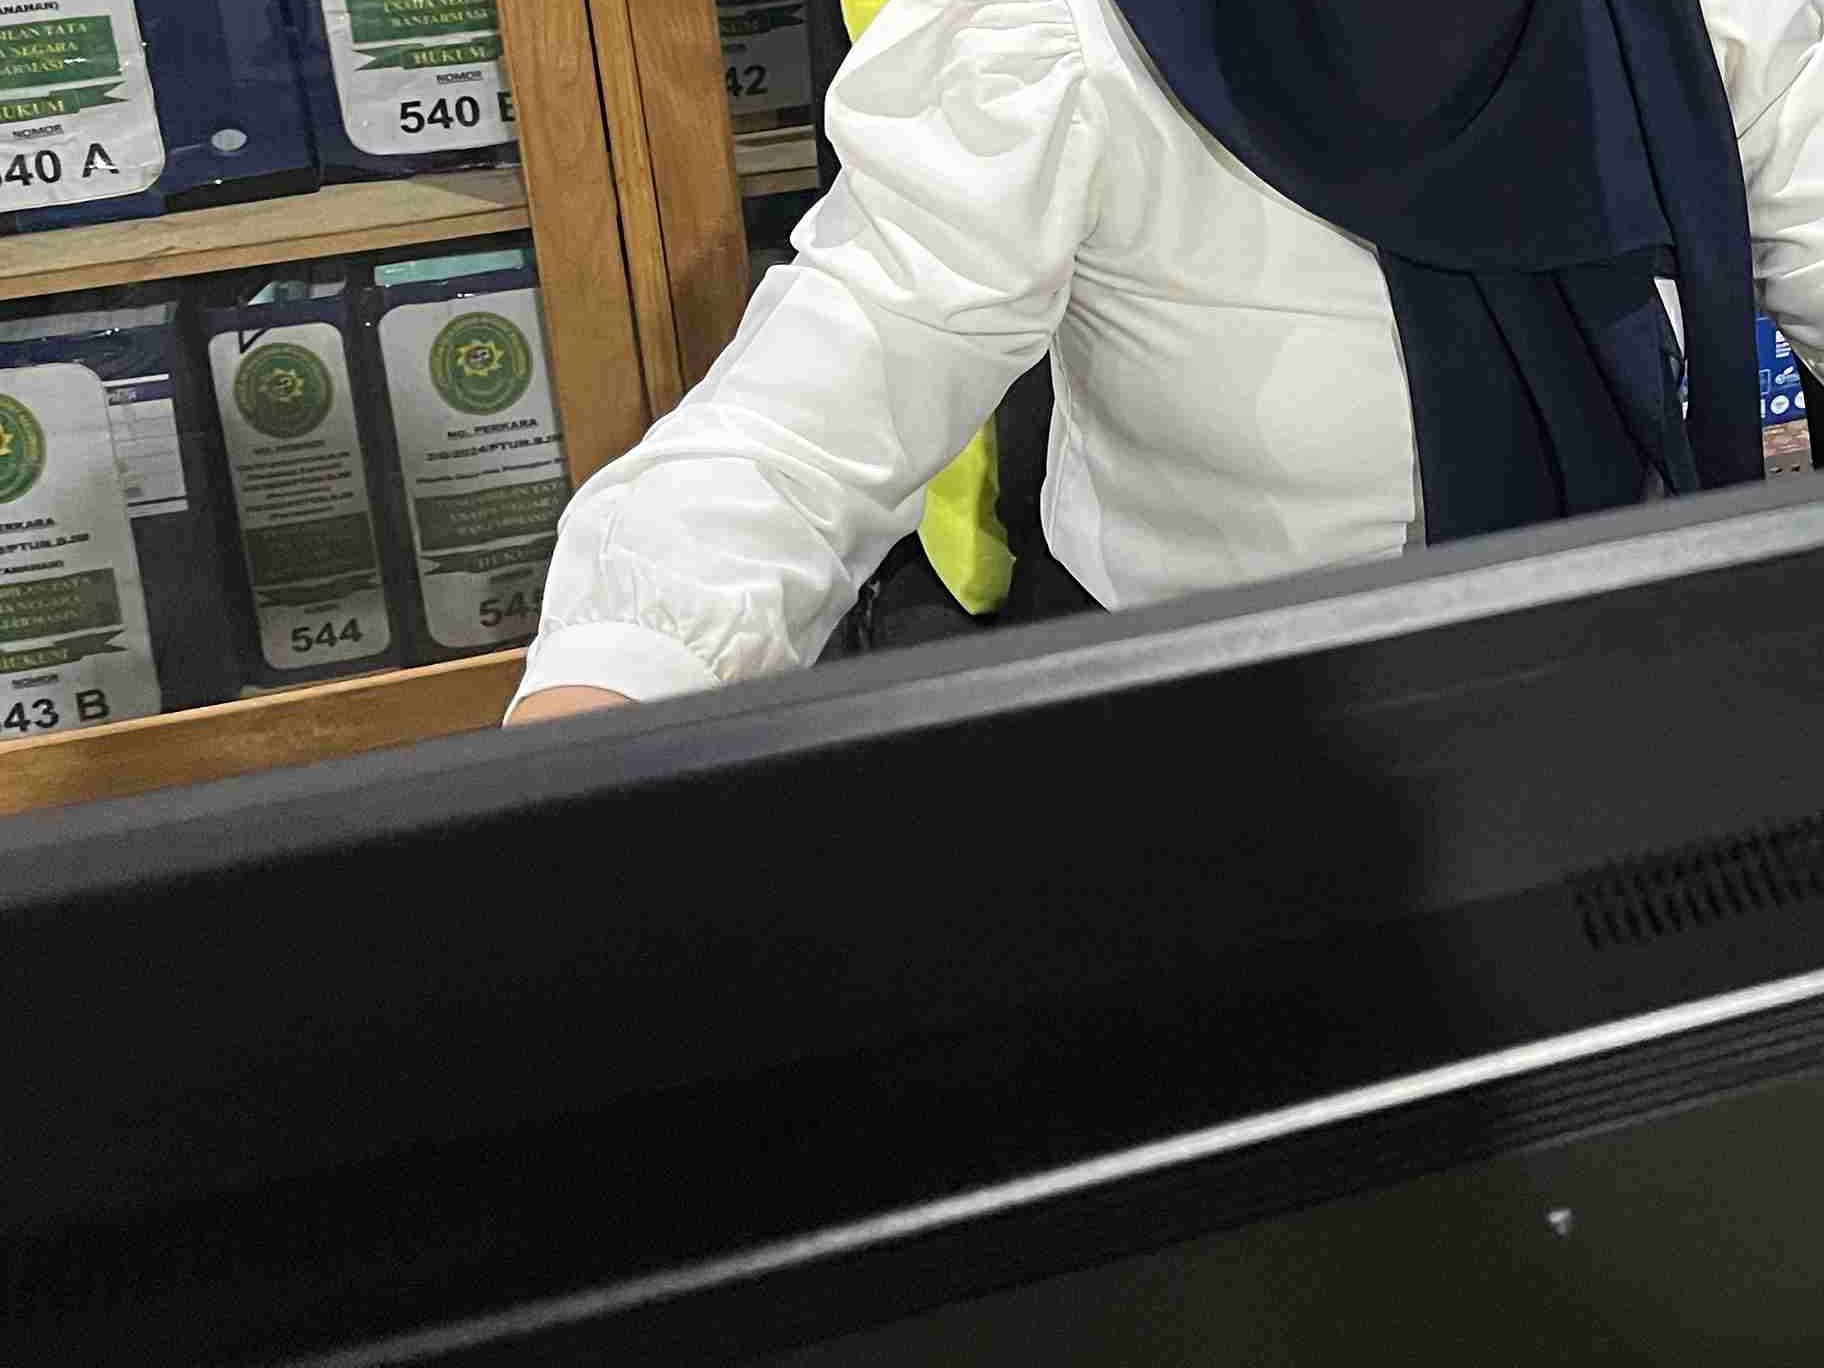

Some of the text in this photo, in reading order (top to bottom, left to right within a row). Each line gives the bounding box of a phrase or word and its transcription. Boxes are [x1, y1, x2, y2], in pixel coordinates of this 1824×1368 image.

[47, 22, 90, 36] TATA
[413, 46, 488, 65] HUKUM
[436, 70, 482, 85] NOMOR
[399, 95, 481, 133] 540
[12, 123, 64, 139] NOMOR
[82, 142, 121, 179] A
[474, 418, 539, 433] PERKARA
[290, 616, 365, 654] 544
[75, 689, 111, 723] B
